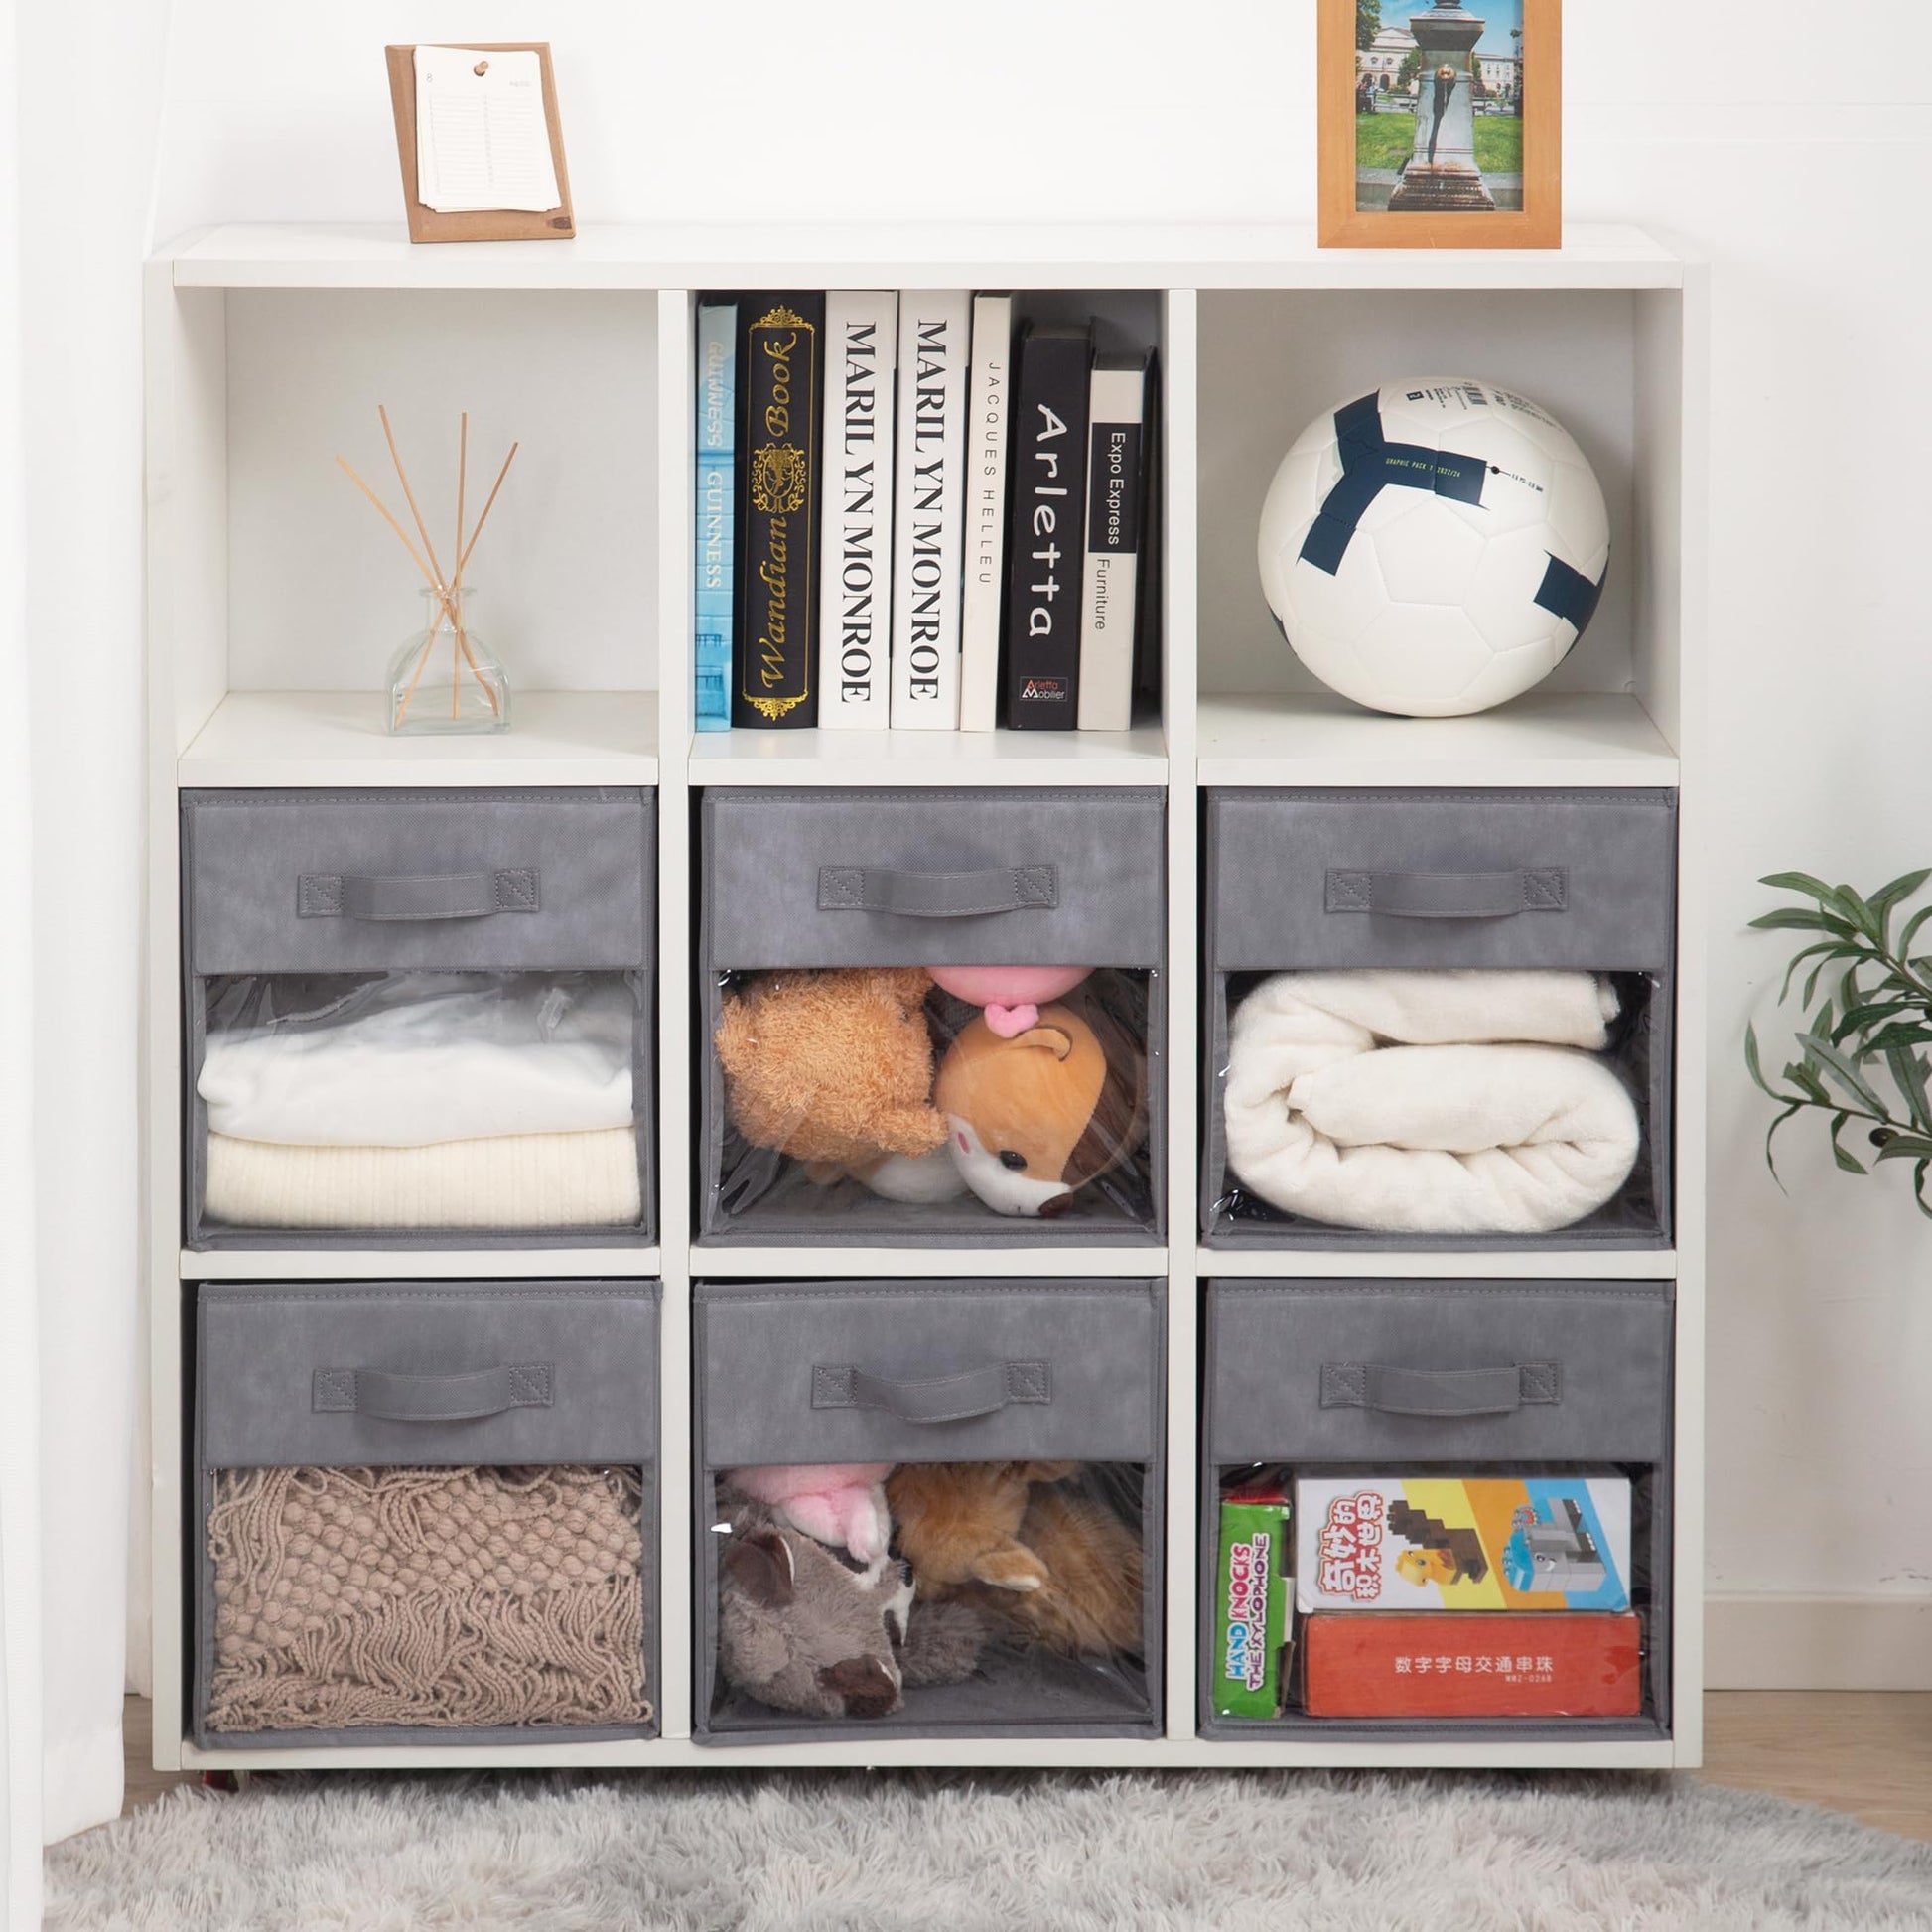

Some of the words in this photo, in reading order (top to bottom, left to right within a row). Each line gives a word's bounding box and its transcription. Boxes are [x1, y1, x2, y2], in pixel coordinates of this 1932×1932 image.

[707, 341, 724, 447] GUINNESS
[763, 332, 797, 437] Book
[844, 321, 877, 515] MARILYN
[913, 319, 947, 512] MARILYN
[983, 362, 1001, 477] JACQUES
[1107, 432, 1126, 475] Expo
[1385, 458, 1410, 468] GRAPHIC
[1411, 462, 1427, 471] PACK
[706, 472, 723, 589] GUINNESS
[978, 490, 996, 584] HELLEU
[1029, 403, 1068, 637] Arletta
[1106, 479, 1124, 545] Express
[759, 516, 788, 689] Wandian
[841, 525, 874, 703] MONROE
[909, 521, 943, 700] MONROE
[1094, 558, 1111, 630] Furniture
[1231, 1545, 1251, 1618] KNOCKS
[1251, 1535, 1267, 1647] XYLOPHONE
[1322, 1498, 1357, 1593] 奇妙的
[1356, 1493, 1383, 1599] 积木世界
[1227, 1624, 1247, 1678] HAND
[1249, 1650, 1263, 1688] THE
[1394, 1656, 1554, 1673] 数字字母交通串珠
